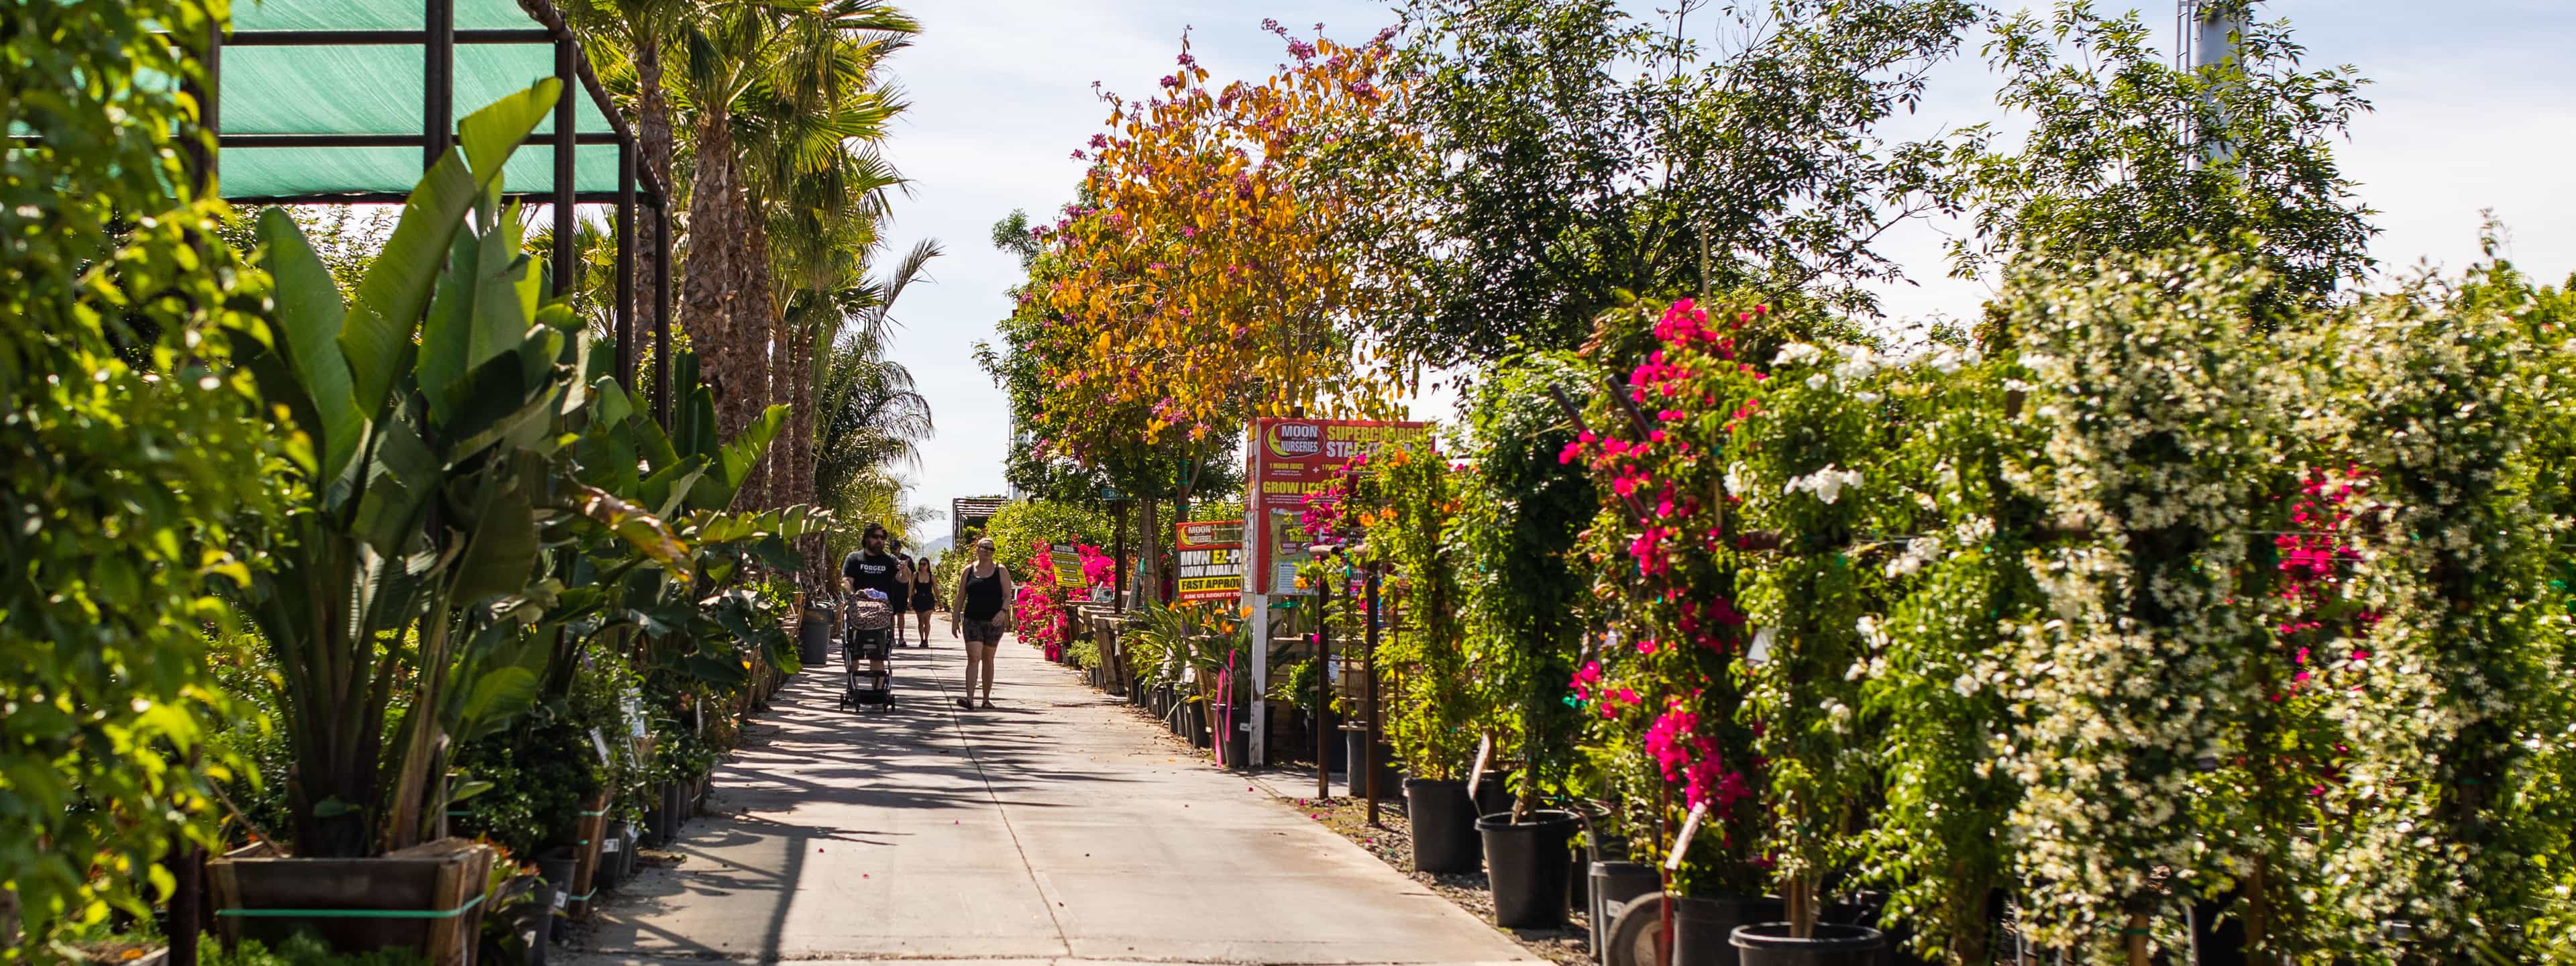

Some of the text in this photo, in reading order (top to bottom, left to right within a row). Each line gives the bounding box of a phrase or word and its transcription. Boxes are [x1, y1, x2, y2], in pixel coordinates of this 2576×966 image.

[1281, 425, 1318, 437] MOON
[1281, 441, 1318, 452] NURSERIES
[1263, 481, 1299, 494] GROW
[1188, 525, 1212, 535] MOON
[1181, 550, 1210, 566] MVN
[860, 564, 885, 572] FORGED
[1181, 564, 1241, 578] NOW AVAILA
[1181, 580, 1205, 590] FAST
